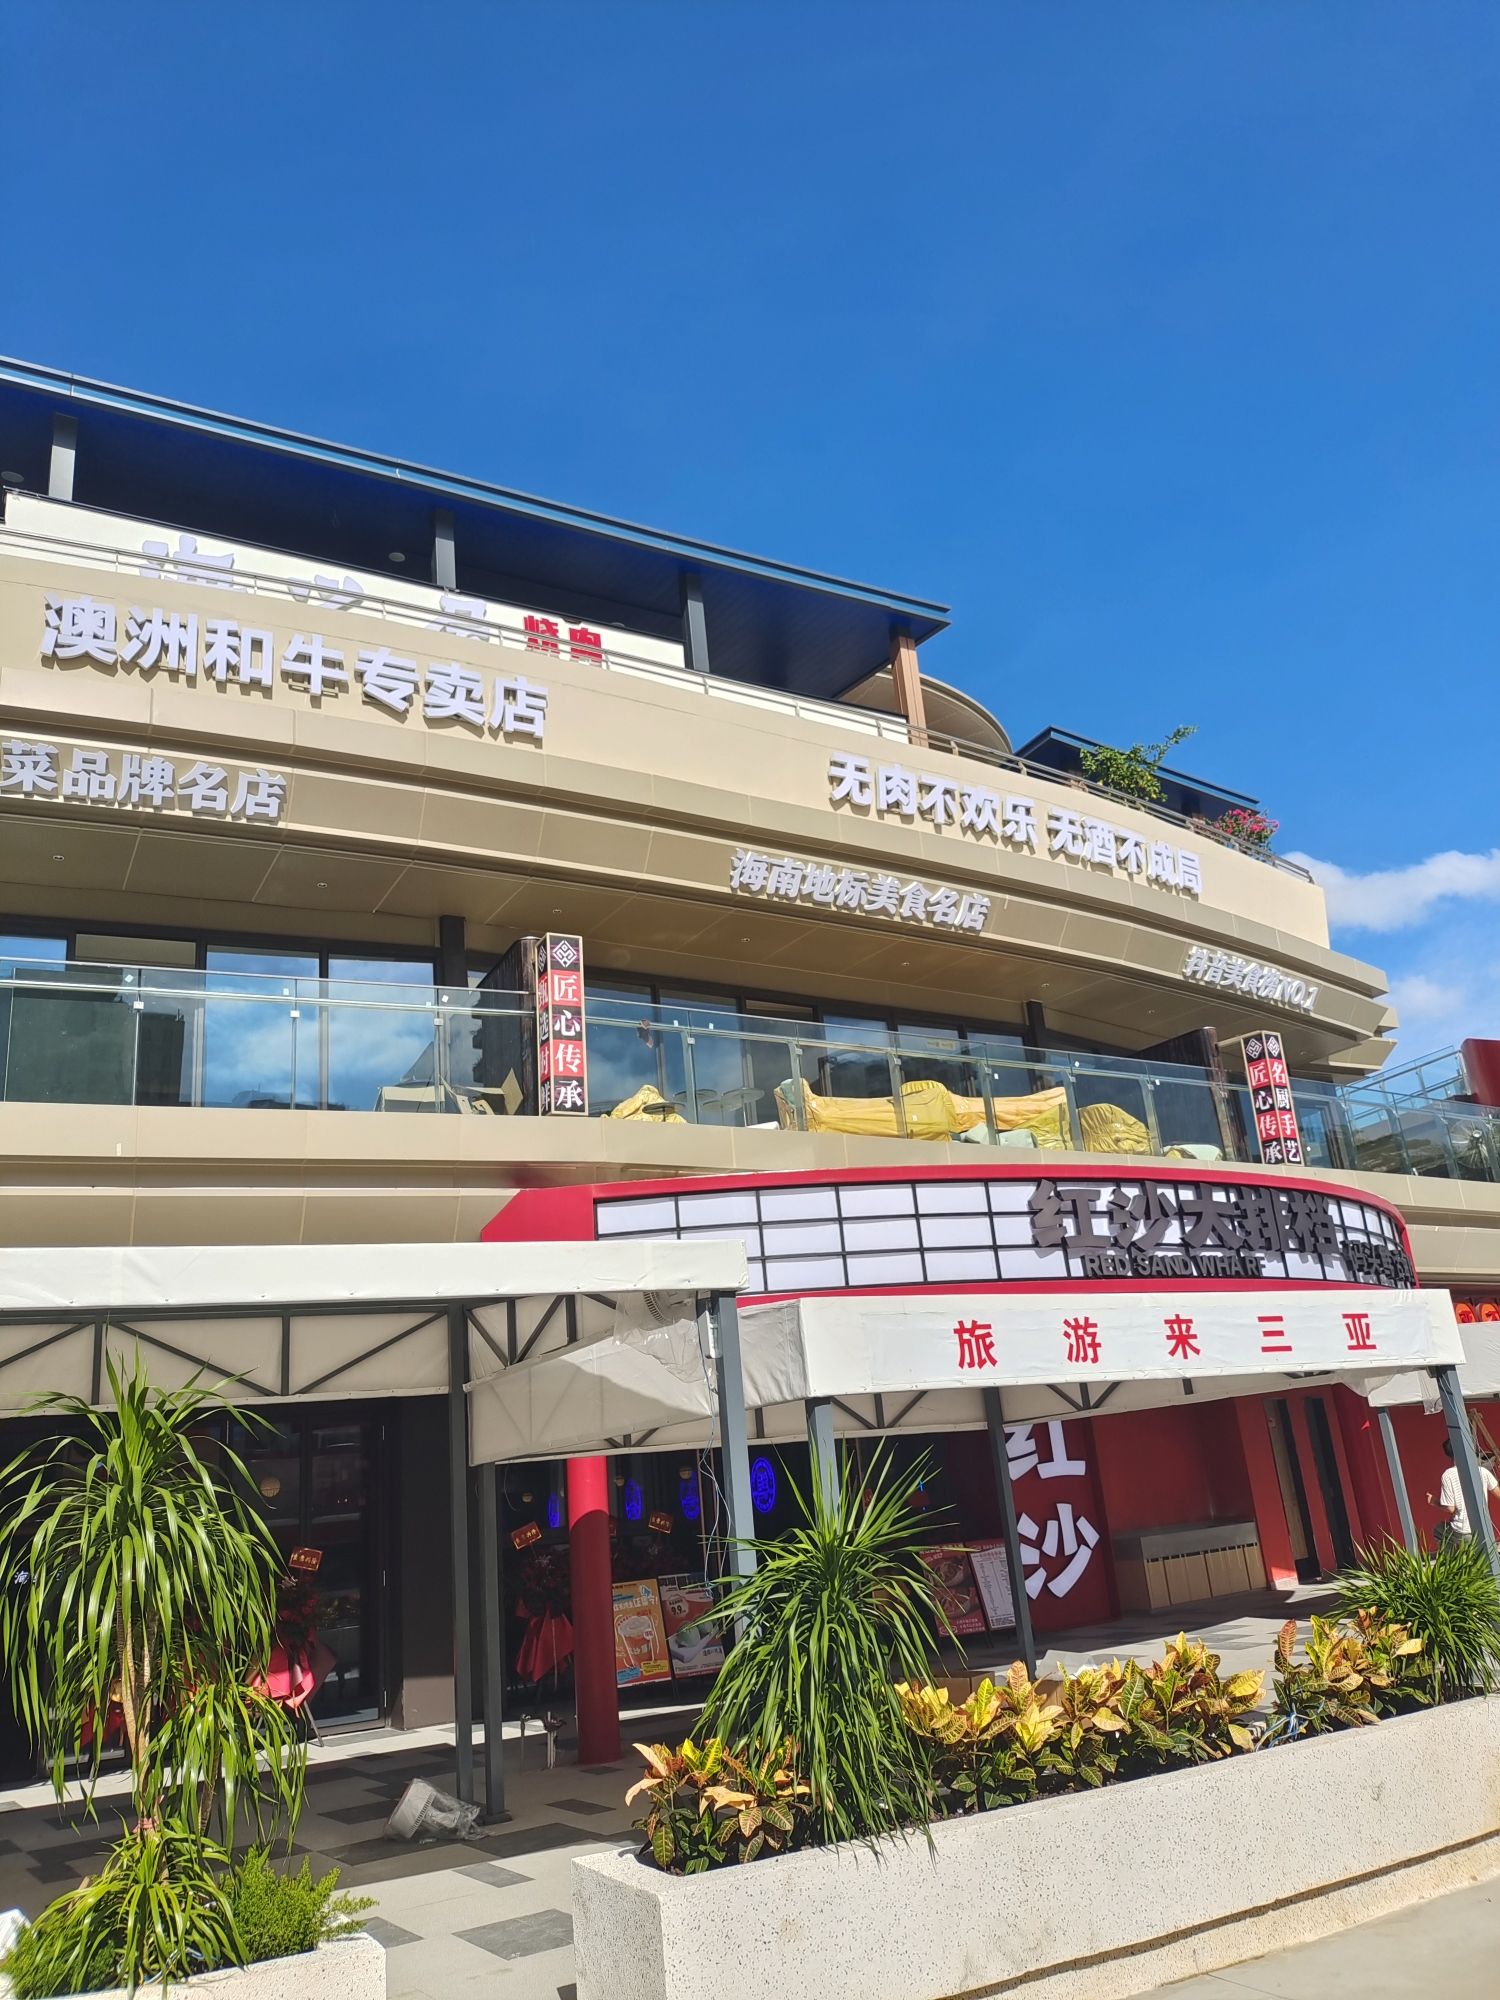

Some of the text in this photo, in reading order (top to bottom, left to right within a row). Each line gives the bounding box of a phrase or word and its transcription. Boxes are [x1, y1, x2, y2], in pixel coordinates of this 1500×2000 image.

[39, 592, 548, 740] 澳洲和牛专卖店
[0, 740, 287, 818] 菜品牌名店
[829, 752, 1203, 896] 无肉不欢乐 无酒不成局
[729, 848, 992, 931] 海南地标美食名店
[552, 975, 583, 1109] 匠心传承
[1249, 1061, 1283, 1164] 匠心传承
[1271, 1061, 1301, 1162] 名厨手艺
[1028, 1179, 1340, 1255] 红沙大排档
[1085, 1254, 1266, 1277] RED SAND WHARF
[1003, 1420, 1100, 1600] 红沙
